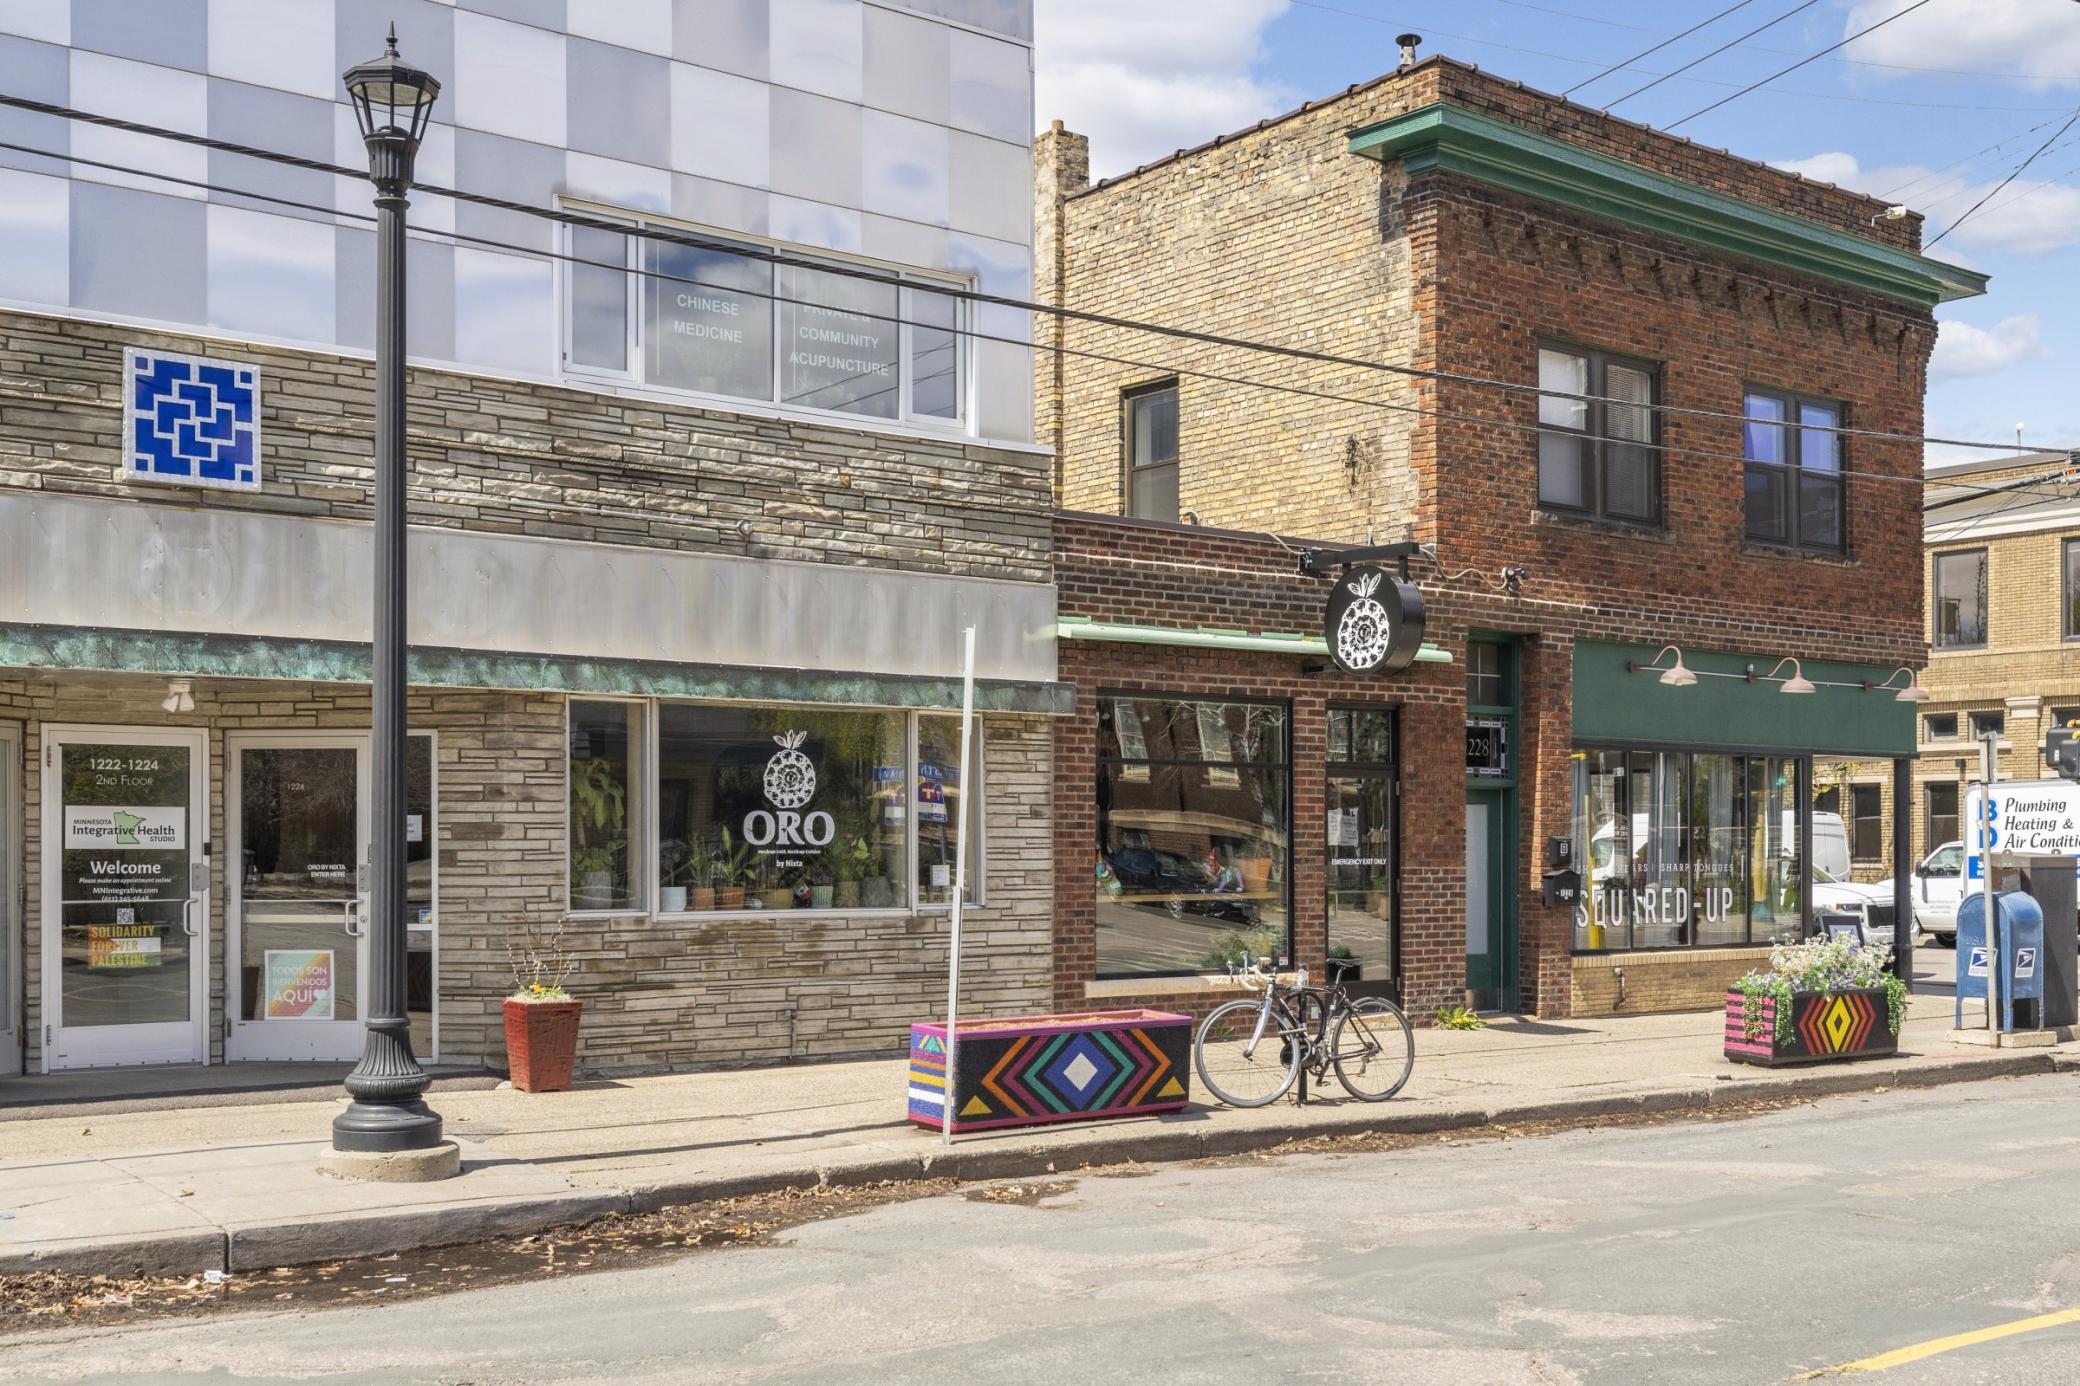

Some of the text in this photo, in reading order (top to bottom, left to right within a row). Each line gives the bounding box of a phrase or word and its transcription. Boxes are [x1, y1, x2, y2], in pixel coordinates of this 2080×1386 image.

[677, 294, 740, 316] CHINESE
[674, 320, 743, 344] MEDICINE
[800, 326, 879, 349] COMMUNITY
[789, 351, 889, 376] ACUPUNCTURE
[90, 758, 160, 771] 1222-1224
[2004, 797, 2067, 814] Plumbing
[73, 825, 175, 838] Integrative Health
[743, 810, 835, 846] ORO
[2004, 815, 2074, 832] Heating &
[2004, 832, 2080, 849] Air Conditi
[90, 860, 161, 875] Welcome
[776, 860, 785, 869] by
[1660, 863, 1689, 873] SHARP
[1693, 863, 1734, 872] TONGUES
[93, 887, 158, 896] MNIntegrative.com
[1577, 887, 1733, 929] SQUARED-UP
[91, 925, 155, 938] SOLIDARITY
[91, 953, 147, 967] PALESTINE
[306, 966, 327, 975] SON
[274, 986, 312, 1006] AQUÍ
